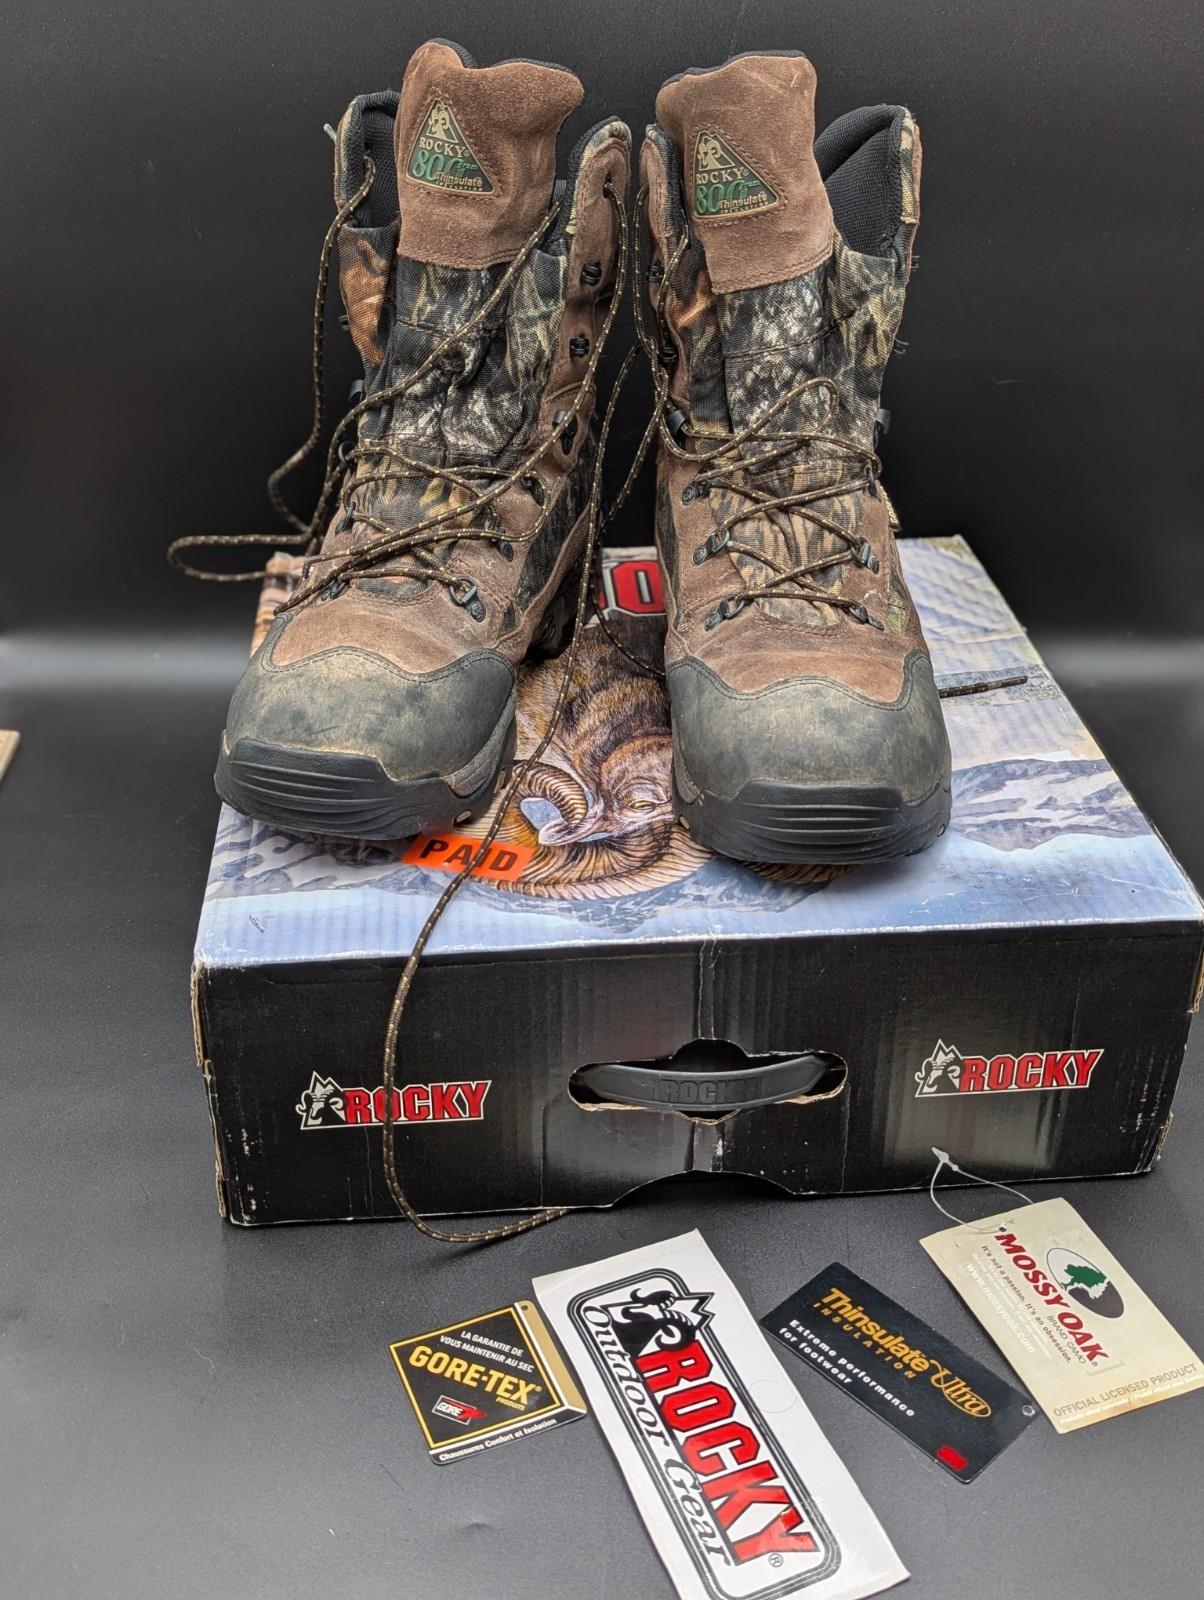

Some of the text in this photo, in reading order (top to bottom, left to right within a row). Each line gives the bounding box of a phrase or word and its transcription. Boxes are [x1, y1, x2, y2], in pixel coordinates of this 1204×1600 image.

[419, 137, 466, 158] ROCKY
[695, 167, 745, 184] ROCKY
[419, 839, 518, 871] PAID
[659, 1077, 763, 1105] ROCKY
[958, 1050, 1102, 1092] ROCKY
[343, 1081, 491, 1125] ROCKY
[994, 1233, 1071, 1308] MOSSY
[1057, 1312, 1109, 1361] OAK
[440, 1335, 535, 1373] VOUS MAINTENIR AU SEC
[460, 1330, 524, 1357] LA GARANTIE DE
[779, 1327, 852, 1384] for footwear
[813, 1302, 917, 1379] INSULATION
[822, 1287, 930, 1372] Thinsulate
[929, 1360, 990, 1417] Ultra
[1047, 1315, 1086, 1364] BRAND CAMO
[789, 1319, 915, 1417] Extreme performance
[1053, 1396, 1100, 1417] OFFICIAL
[1100, 1381, 1149, 1401] LICENSED
[1150, 1363, 1198, 1385] PRODUCT
[436, 1402, 463, 1416] GORE
[484, 1433, 513, 1447] Confort
[513, 1430, 523, 1438] et
[523, 1418, 557, 1434] Isolation
[583, 1304, 733, 1568] Outdoor Gear
[634, 1339, 822, 1566] ROCKY
